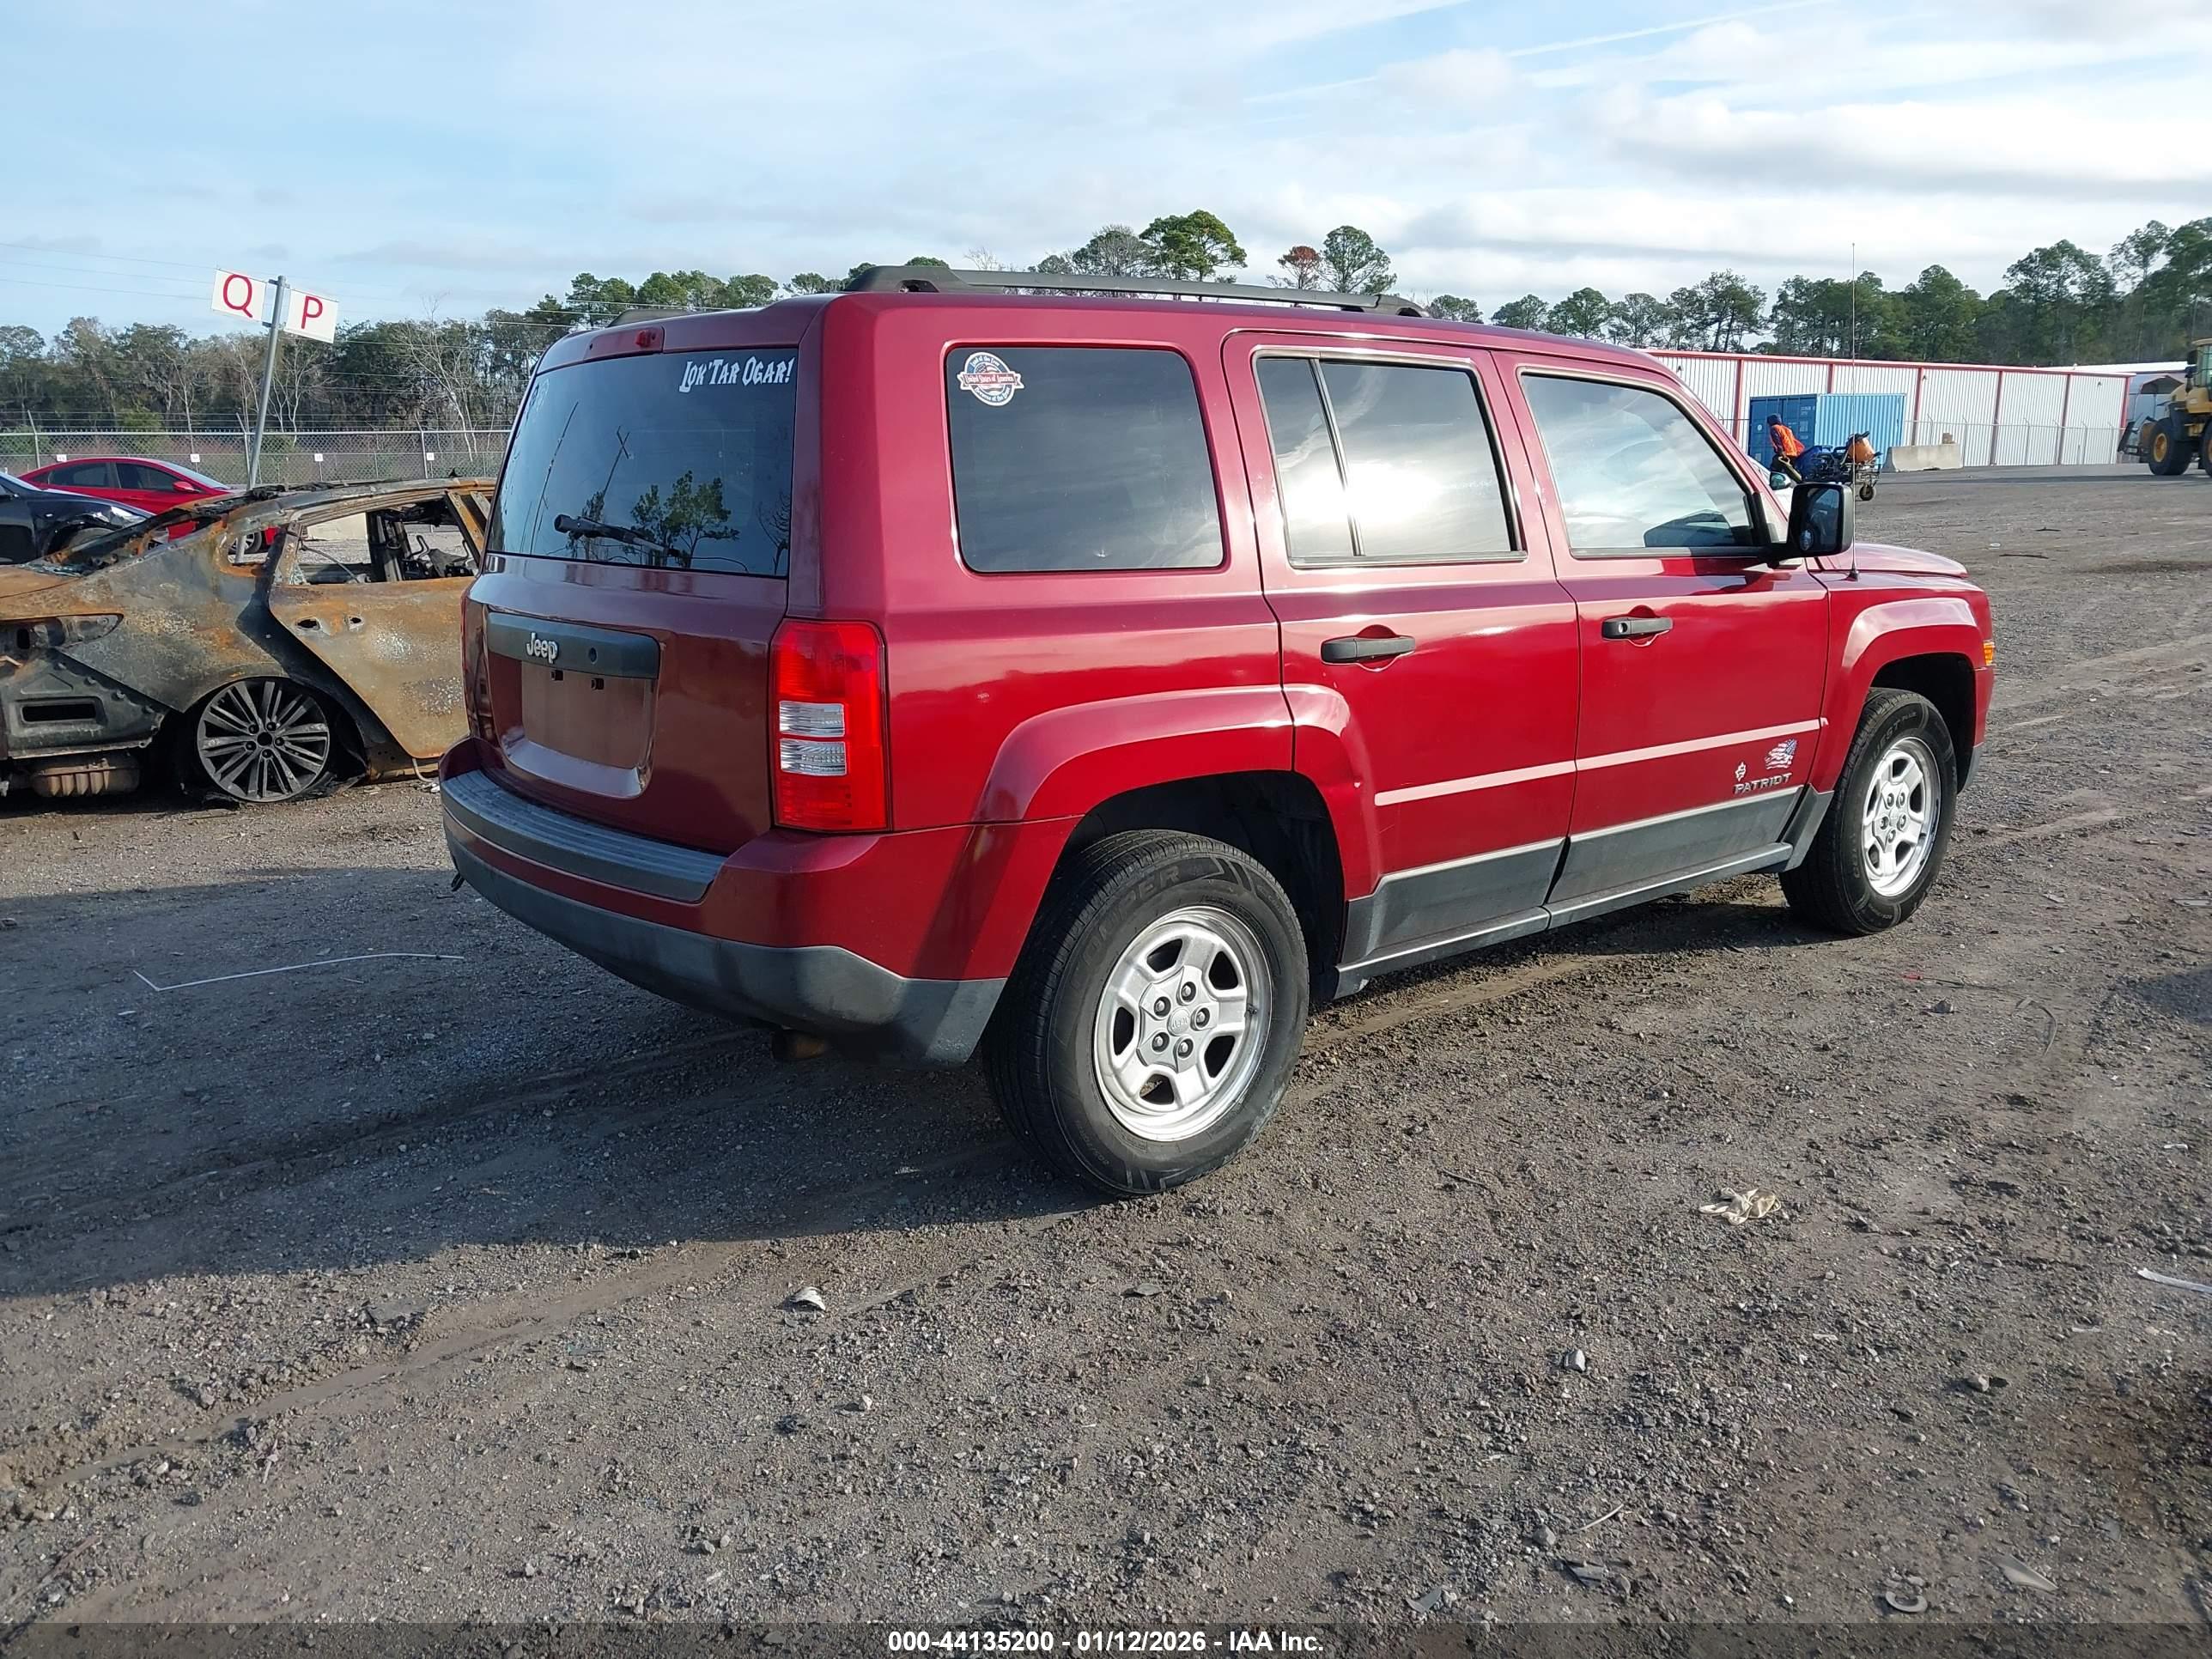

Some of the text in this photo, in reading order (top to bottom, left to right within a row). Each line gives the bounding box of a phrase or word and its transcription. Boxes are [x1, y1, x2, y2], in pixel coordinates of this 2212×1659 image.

[222, 273, 252, 318] Q
[301, 295, 323, 329] P
[526, 632, 558, 664] Jeep
[1734, 772, 1793, 794] PATRIOT
